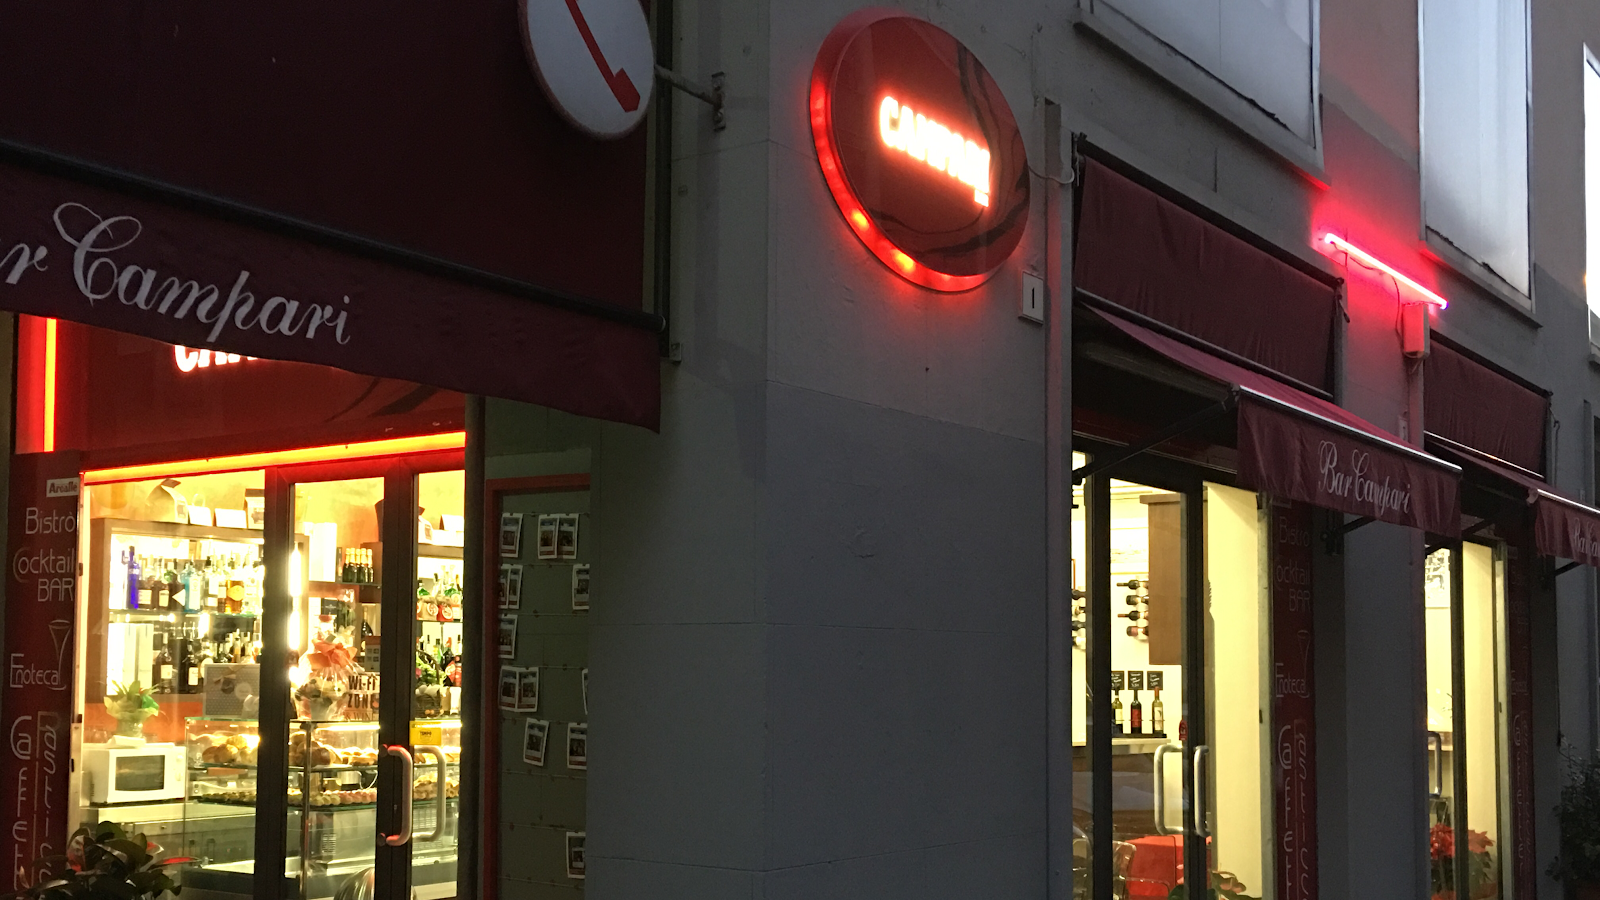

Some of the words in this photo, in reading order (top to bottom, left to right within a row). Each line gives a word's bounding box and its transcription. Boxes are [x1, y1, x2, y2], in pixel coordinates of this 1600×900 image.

[0, 243, 48, 285] r
[53, 202, 350, 345] Campari
[1318, 440, 1352, 497] Bar
[1352, 449, 1411, 516] Campari
[25, 507, 76, 535] Bistrò
[13, 546, 75, 583] Cocktail
[37, 578, 74, 601] BAR
[1288, 588, 1311, 612] BAR
[10, 653, 60, 688] Enoteca
[1275, 663, 1307, 697] Enoteca
[10, 715, 32, 900] Caffett
